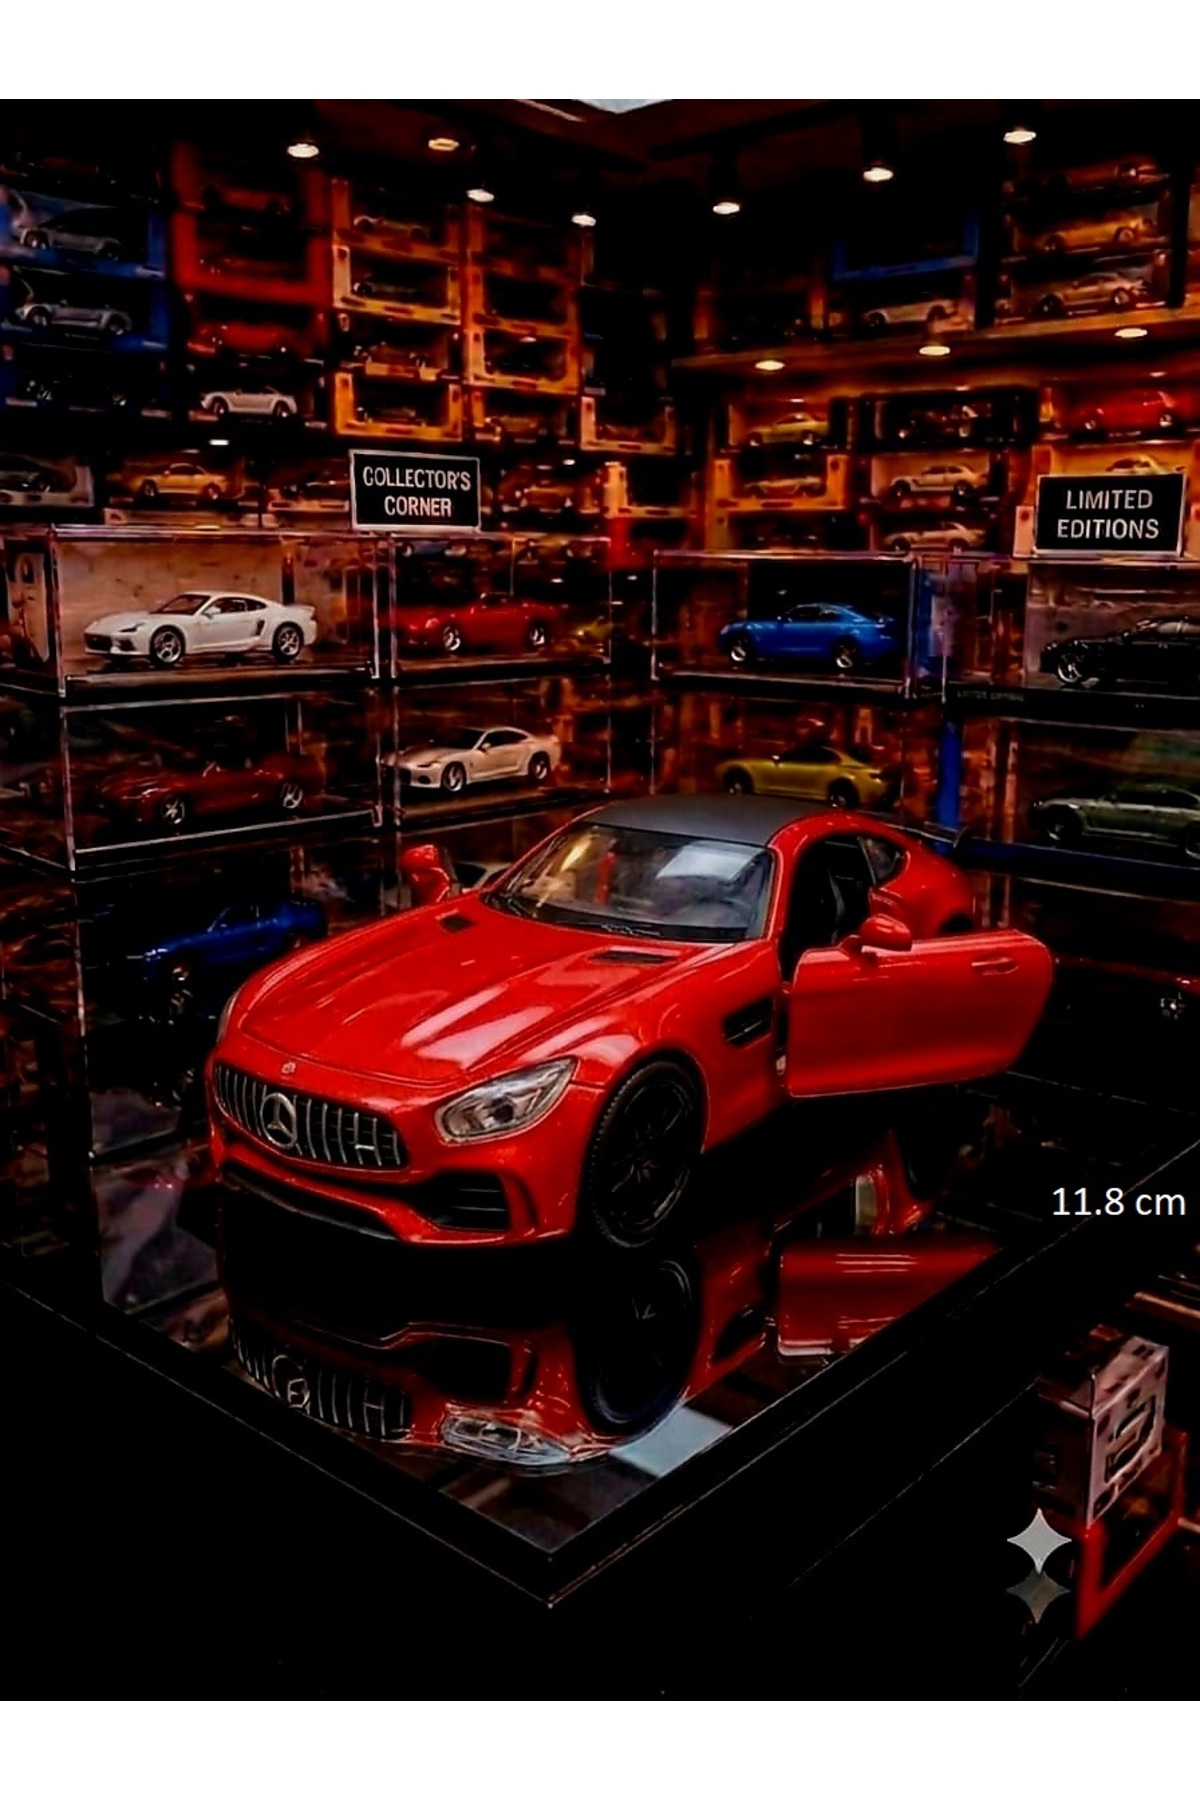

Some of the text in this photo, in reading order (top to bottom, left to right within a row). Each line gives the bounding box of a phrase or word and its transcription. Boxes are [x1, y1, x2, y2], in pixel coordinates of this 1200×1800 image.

[363, 466, 471, 491] COLLECTOR'S
[384, 495, 452, 516] CORNER
[1066, 489, 1153, 510] LIMITED
[1057, 518, 1159, 540] EDITIONS
